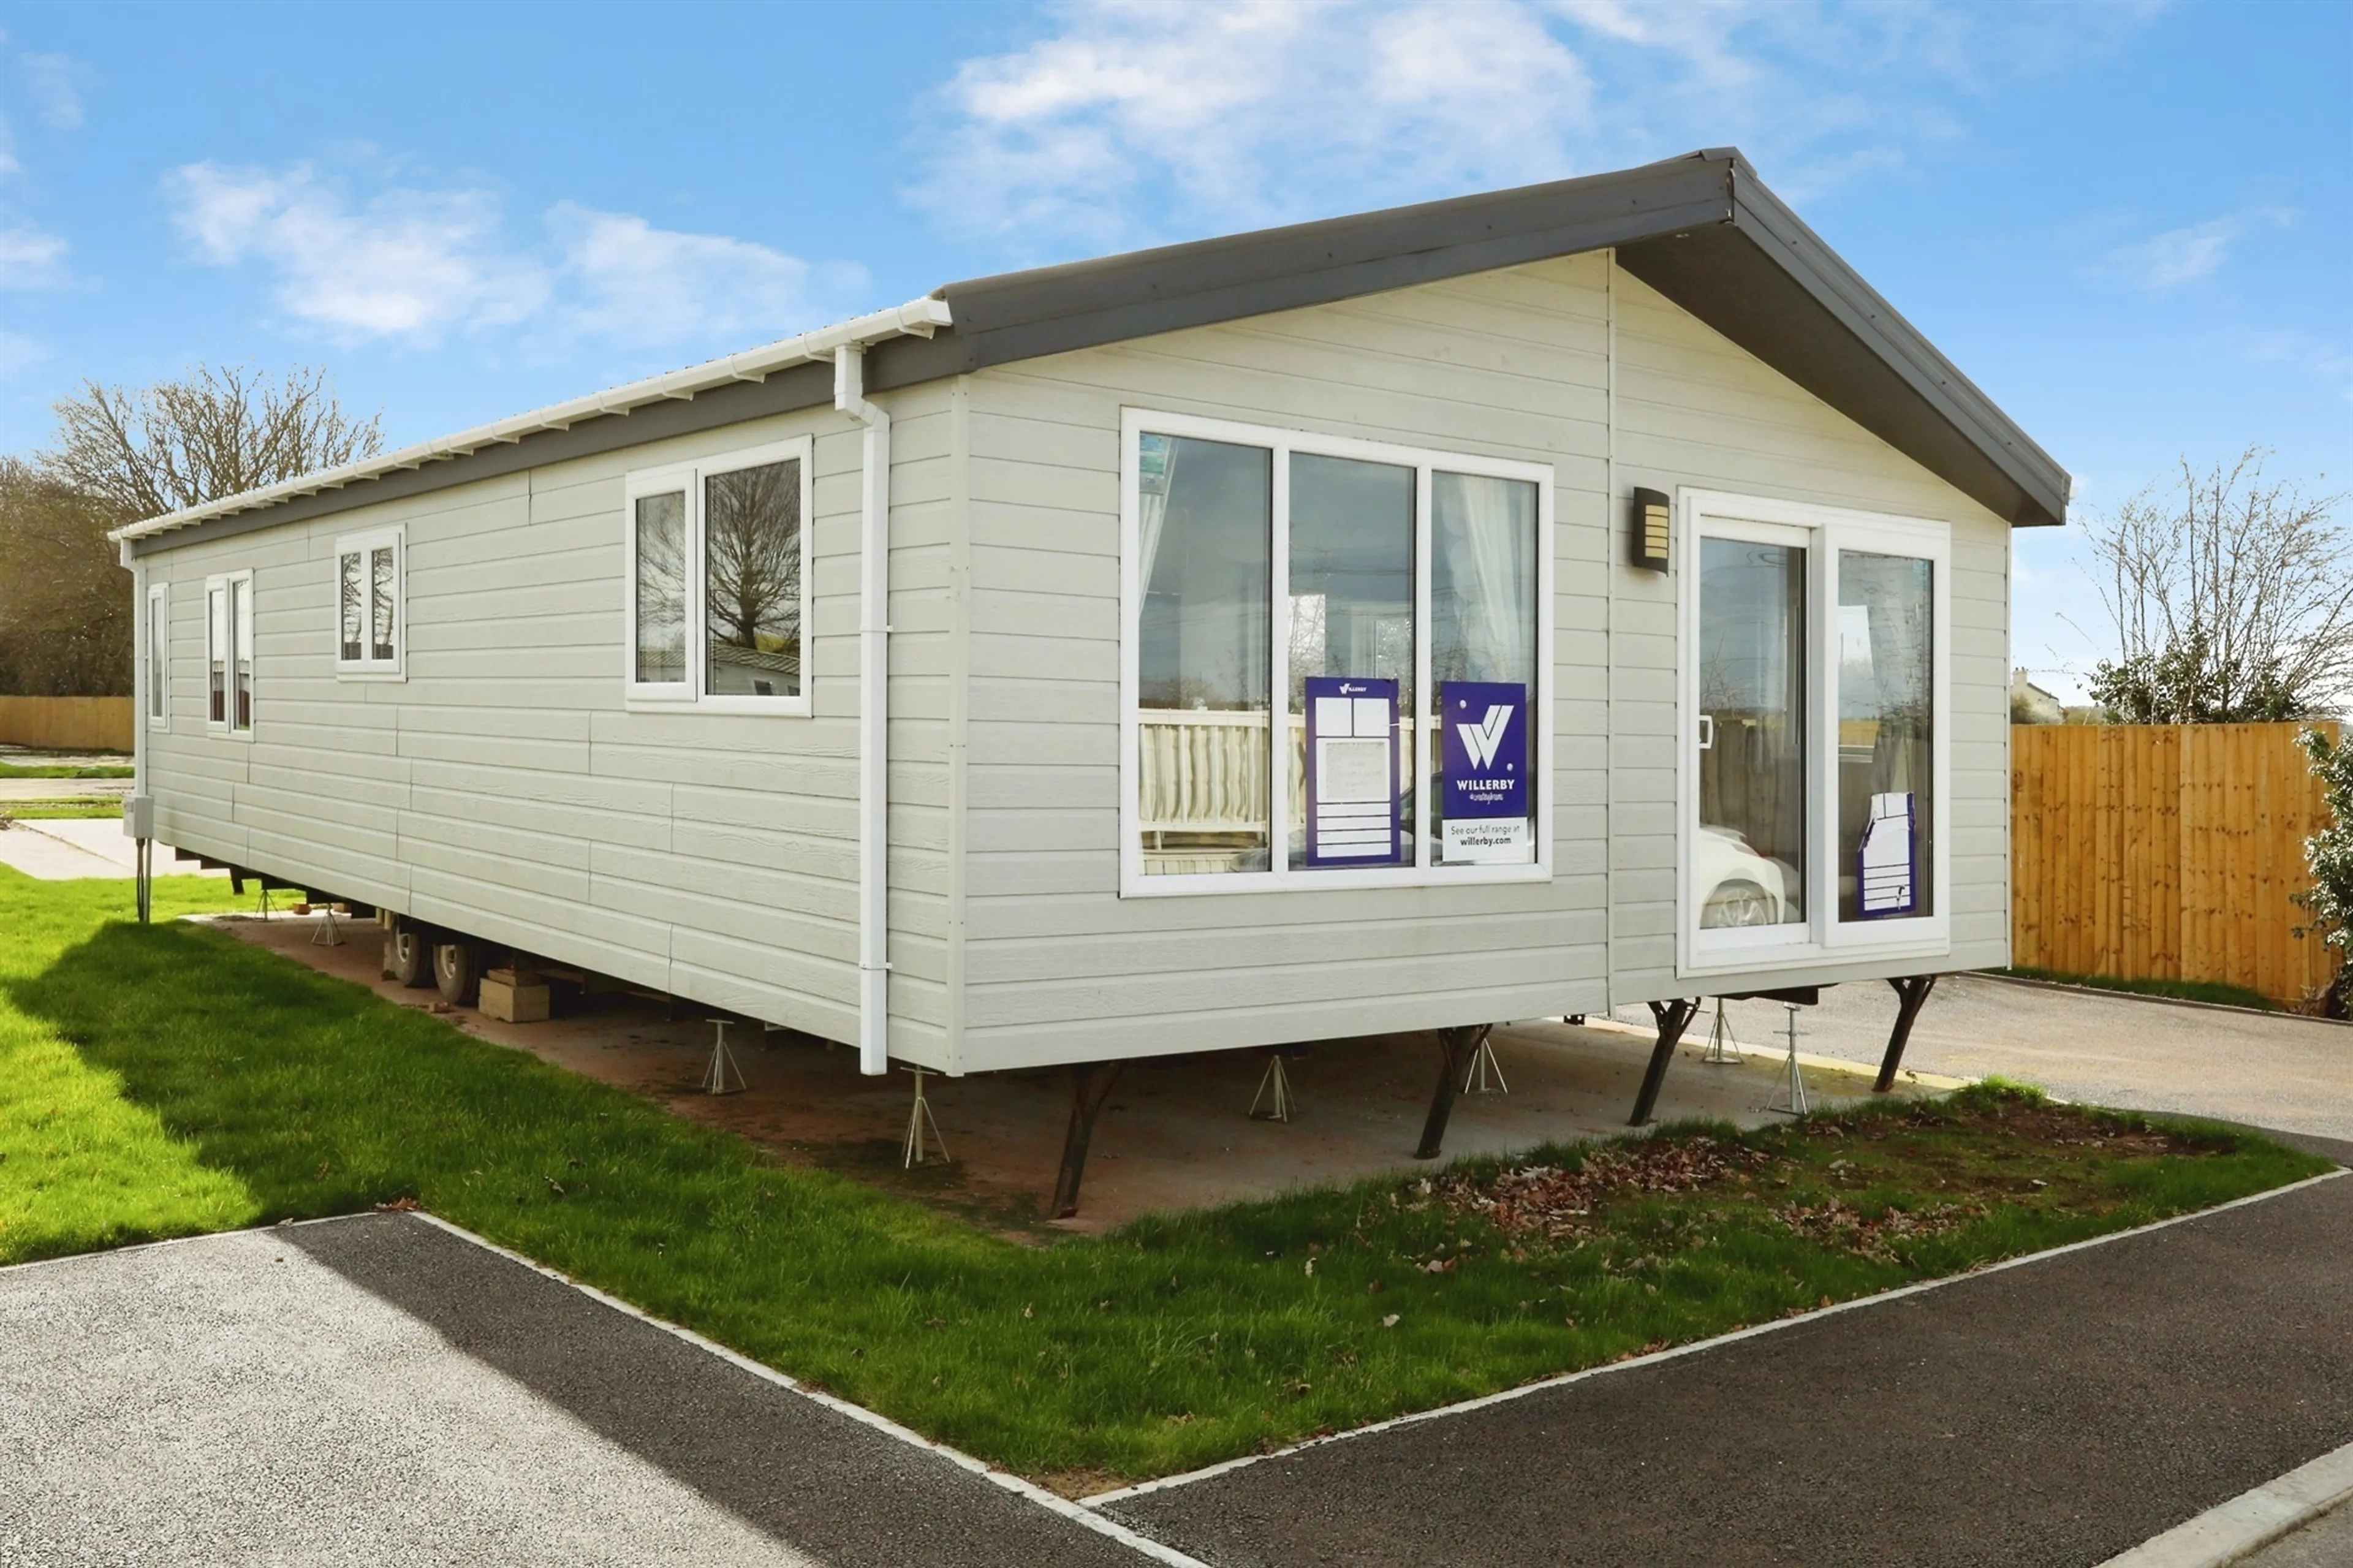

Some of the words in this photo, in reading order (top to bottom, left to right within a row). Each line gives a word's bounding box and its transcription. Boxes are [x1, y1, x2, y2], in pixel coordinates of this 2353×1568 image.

[1339, 683, 1367, 694] WILLERBY
[1457, 779, 1515, 790] WILLERBY
[1451, 826, 1464, 835] See
[1479, 825, 1490, 833] full
[1491, 826, 1512, 835] range
[1460, 837, 1512, 847] willerby.com
